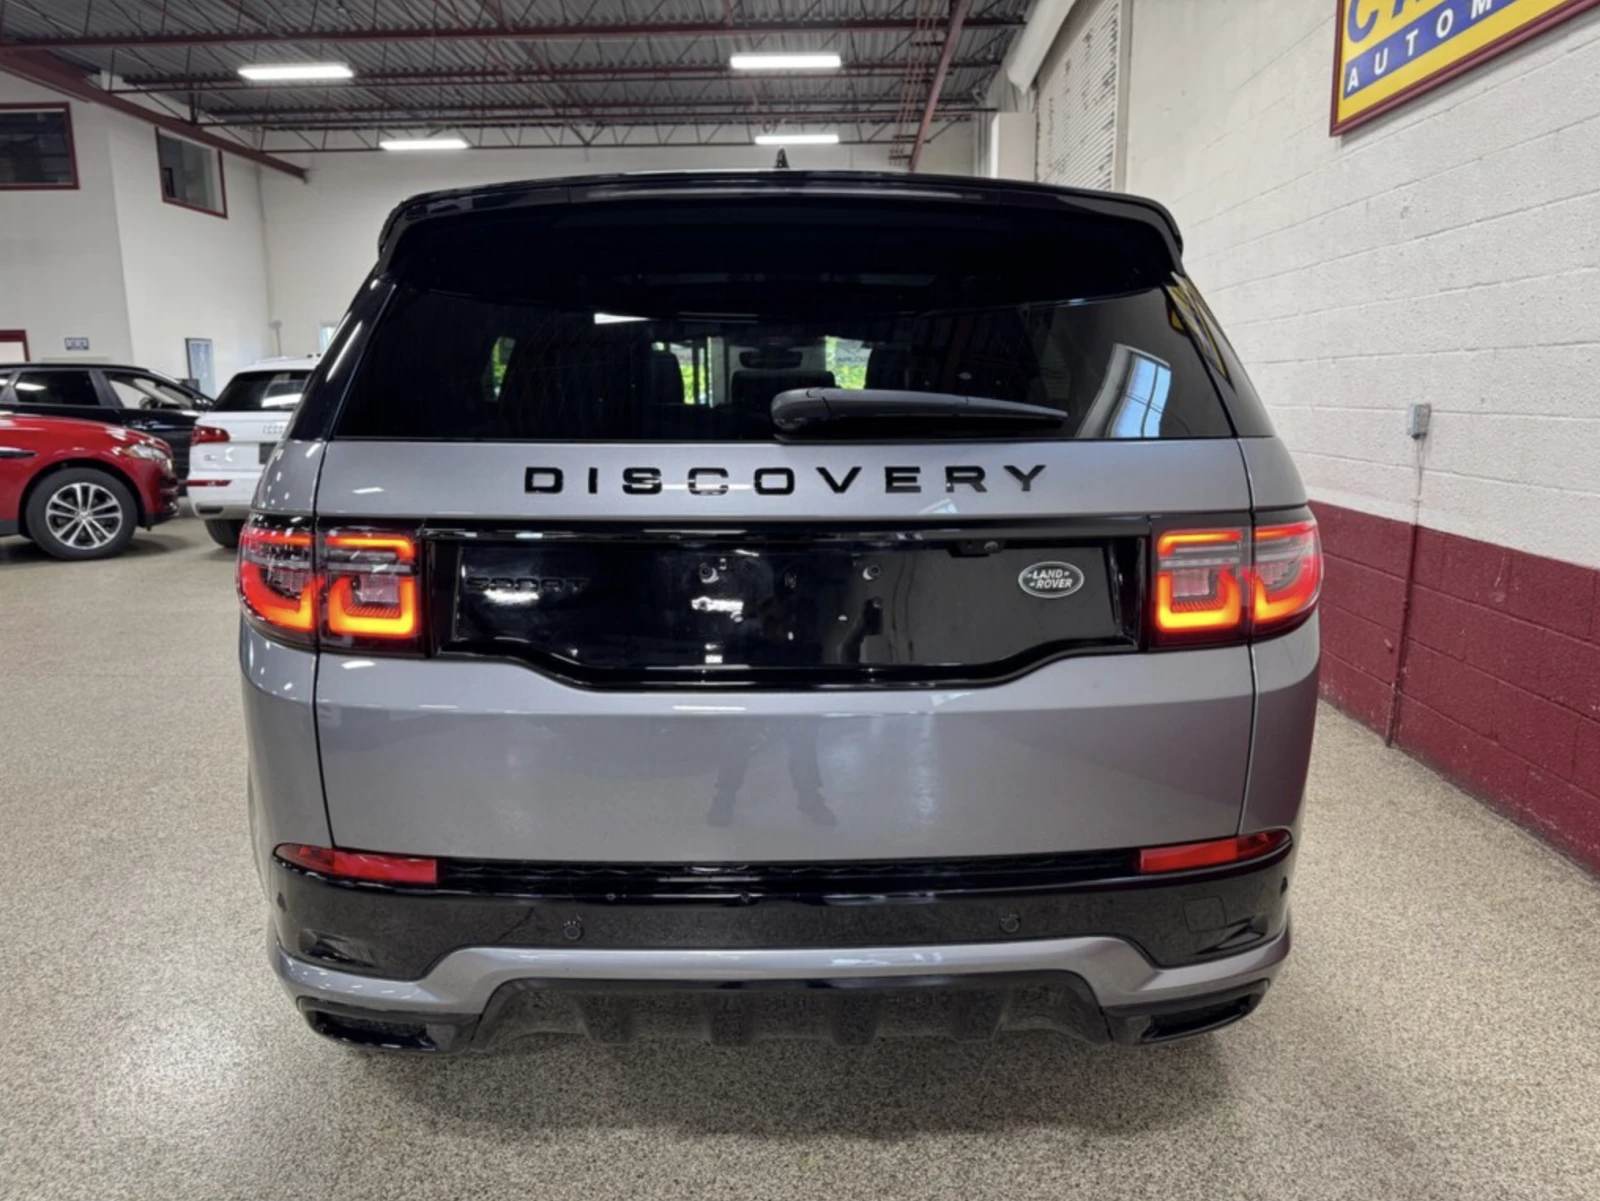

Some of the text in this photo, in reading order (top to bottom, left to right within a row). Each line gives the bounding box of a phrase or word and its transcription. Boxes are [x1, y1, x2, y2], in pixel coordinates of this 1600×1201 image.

[524, 464, 1047, 495] DISCOVERY
[1032, 569, 1063, 579] LAND
[1036, 578, 1073, 589] ROVER
